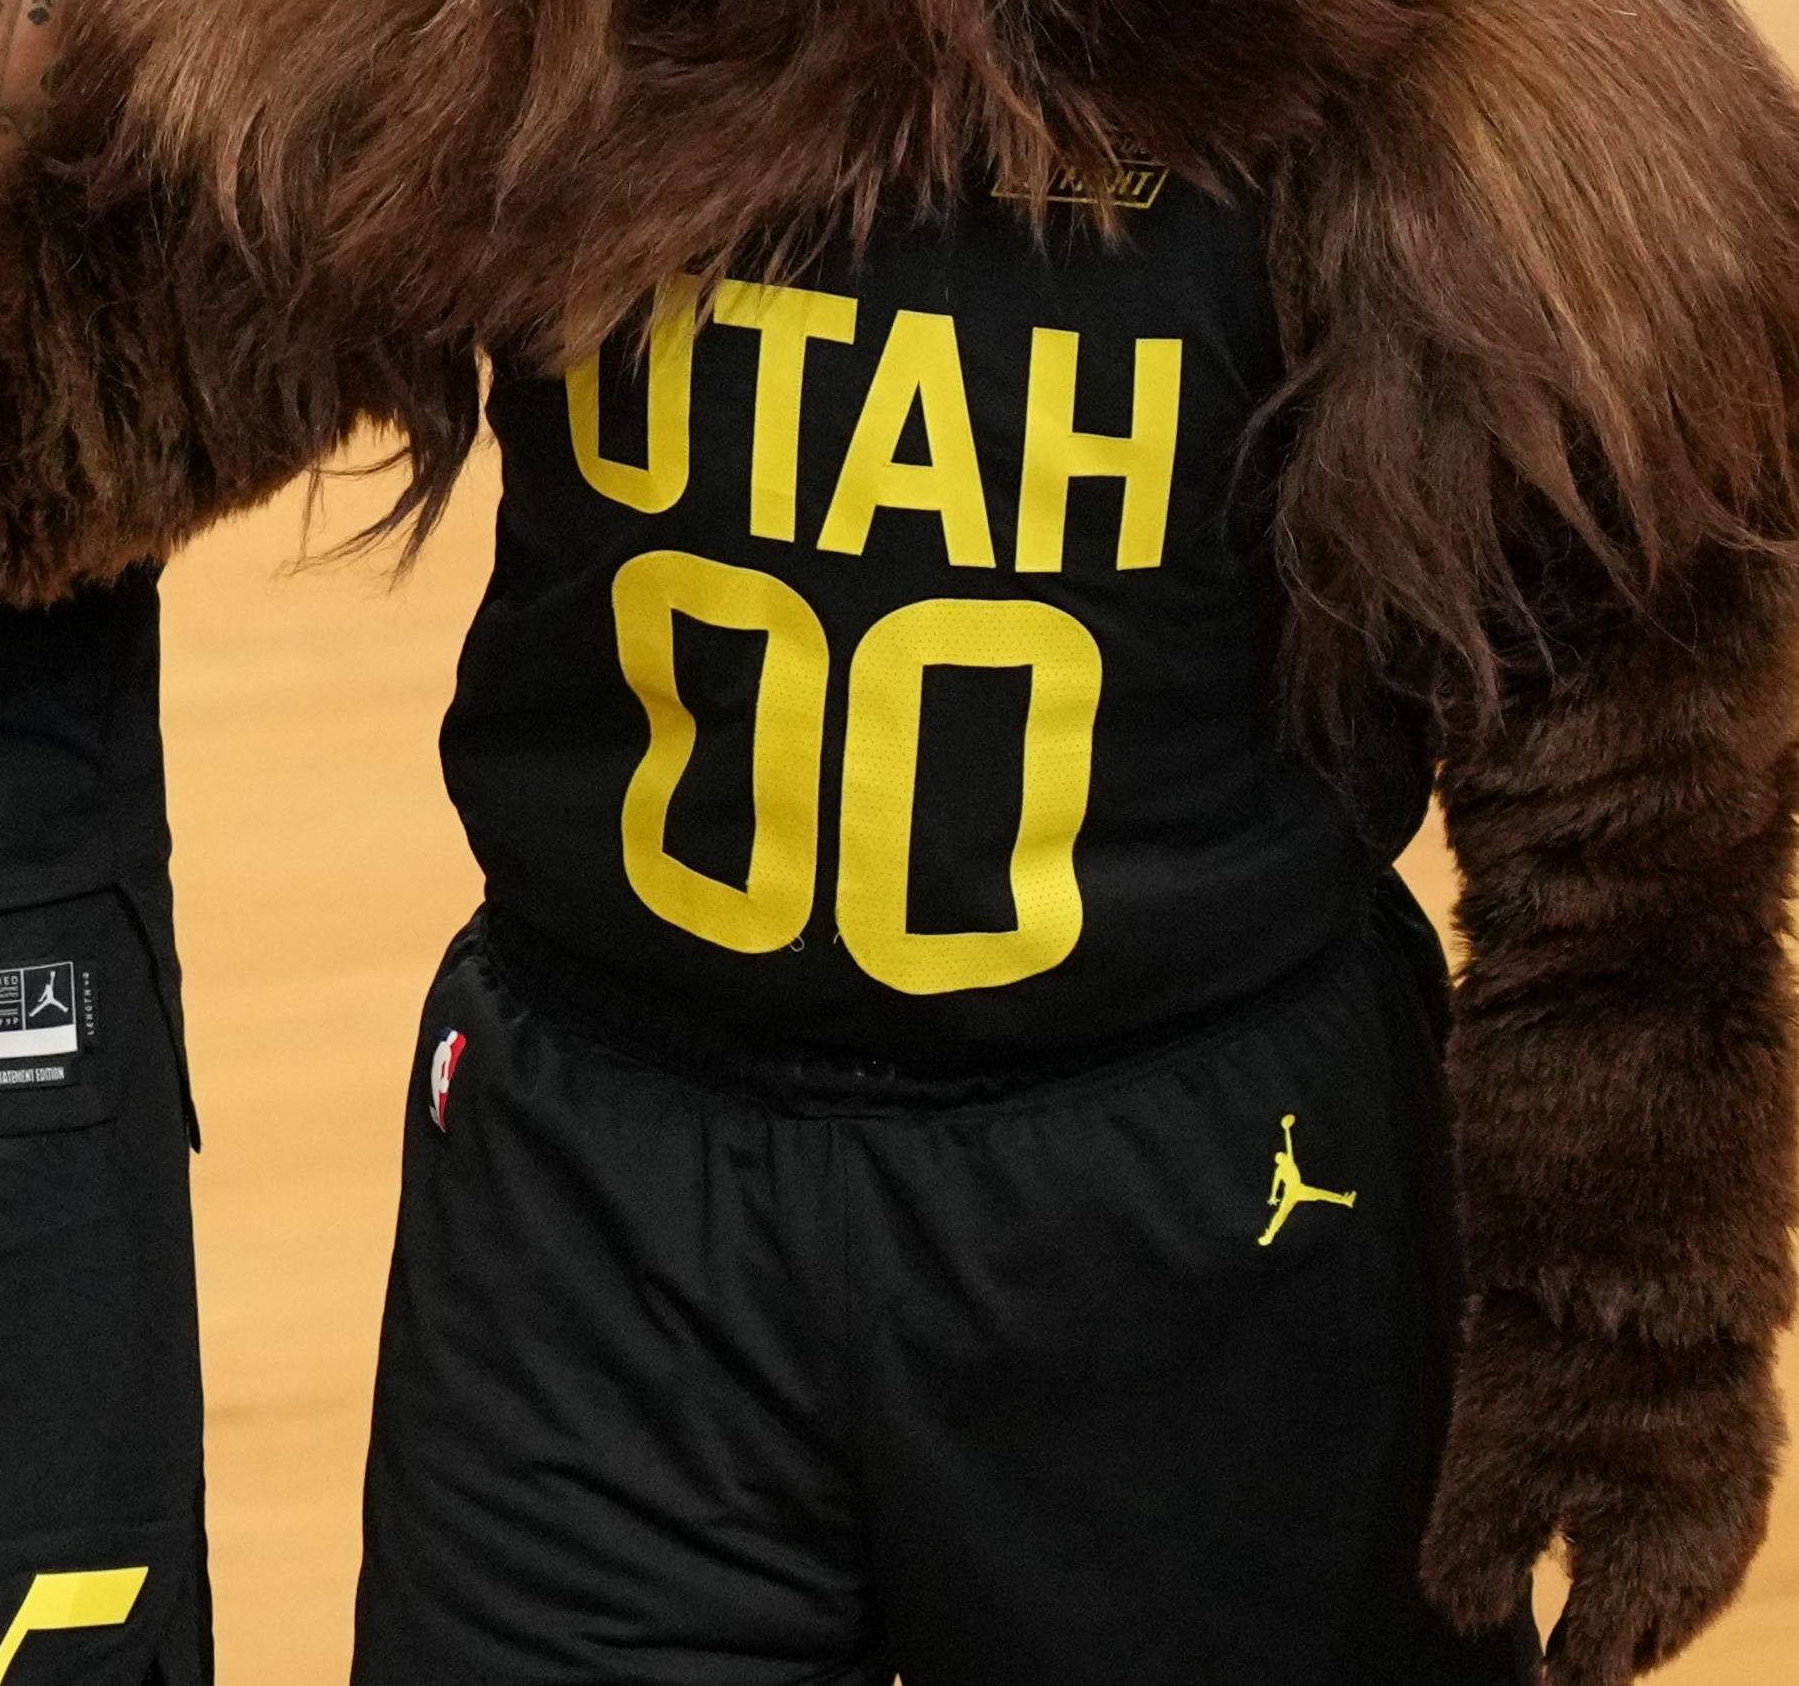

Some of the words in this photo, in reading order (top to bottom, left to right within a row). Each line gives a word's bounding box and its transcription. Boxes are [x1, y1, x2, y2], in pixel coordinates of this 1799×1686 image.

[565, 274, 1182, 572] UTAH
[612, 550, 1103, 996] 00
[35, 1066, 65, 1083] EDITION
